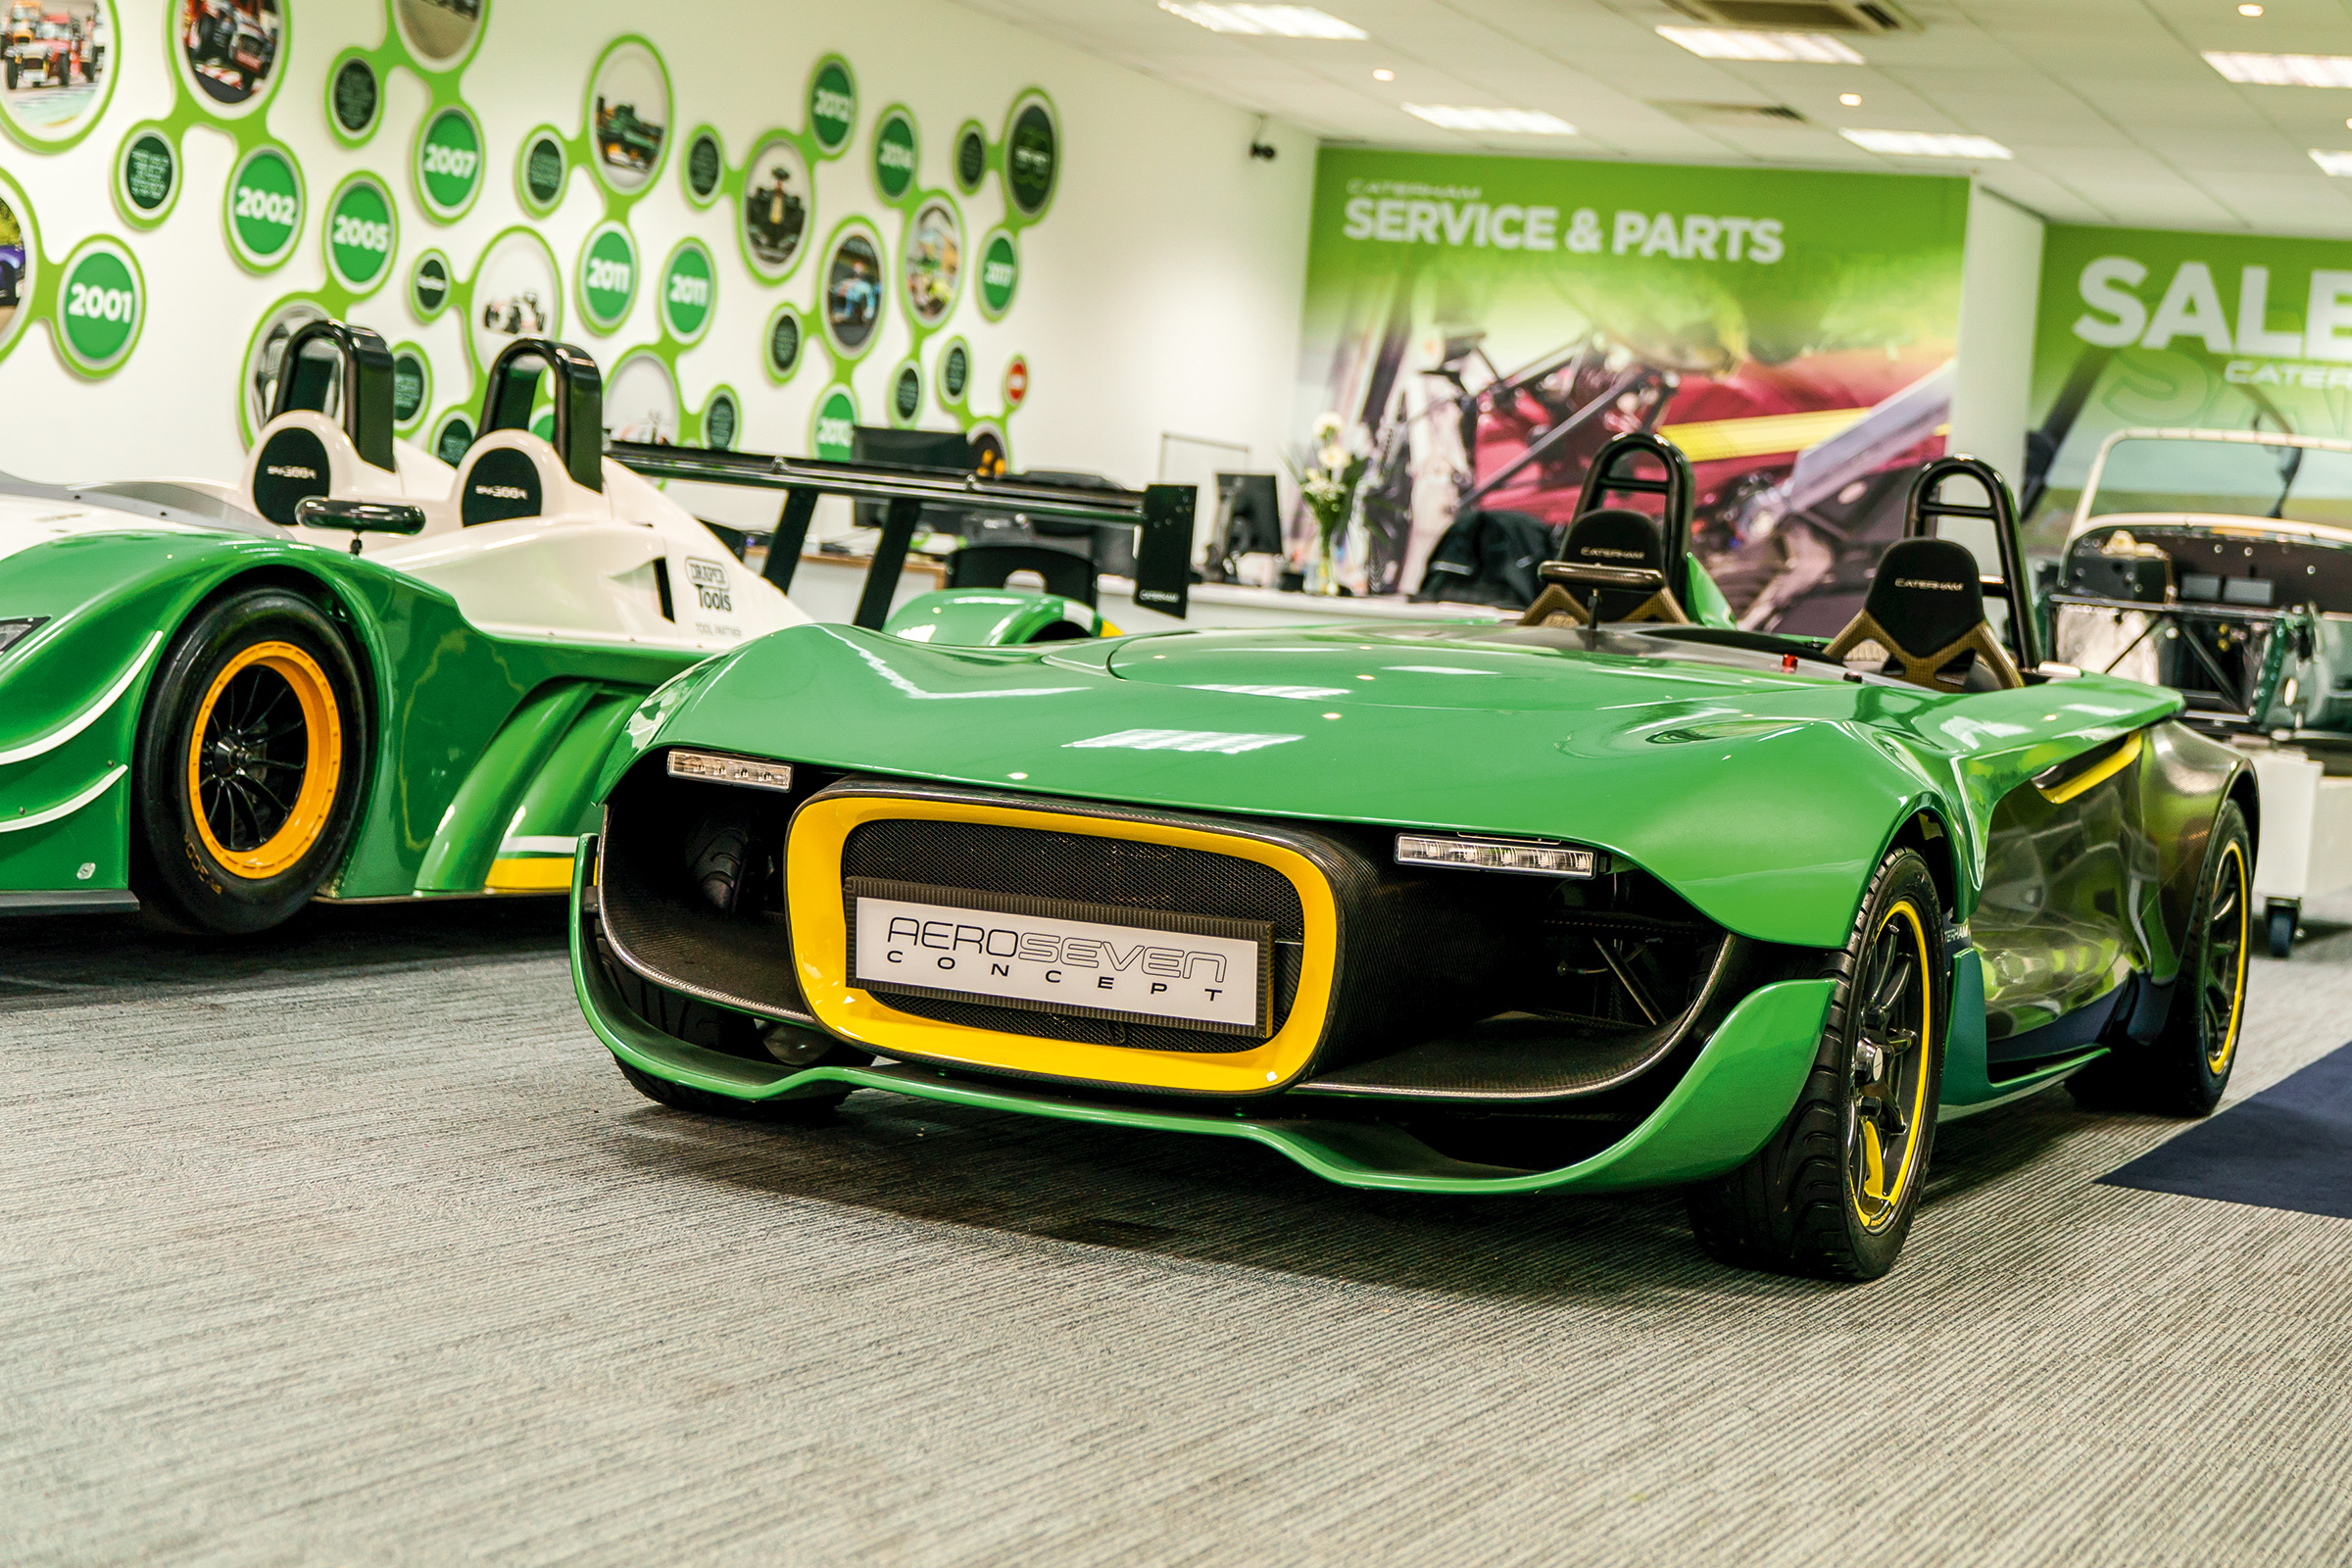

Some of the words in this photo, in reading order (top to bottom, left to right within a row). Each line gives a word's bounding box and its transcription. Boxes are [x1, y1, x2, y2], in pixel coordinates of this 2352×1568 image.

[423, 142, 478, 179] 2007
[235, 184, 296, 225] 2002
[333, 214, 391, 253] 2005
[1343, 197, 1560, 251] SERVICE
[1564, 207, 1604, 254] &
[1611, 209, 1785, 265] PARTS
[588, 257, 630, 294] 2011
[669, 273, 708, 308] 2011
[68, 282, 133, 323] 2001
[2071, 255, 2352, 361] SALE
[1894, 577, 1964, 591] CATERHAM
[887, 916, 1227, 983] AEROSEVEN
[886, 951, 1223, 1002] CONCEPT
